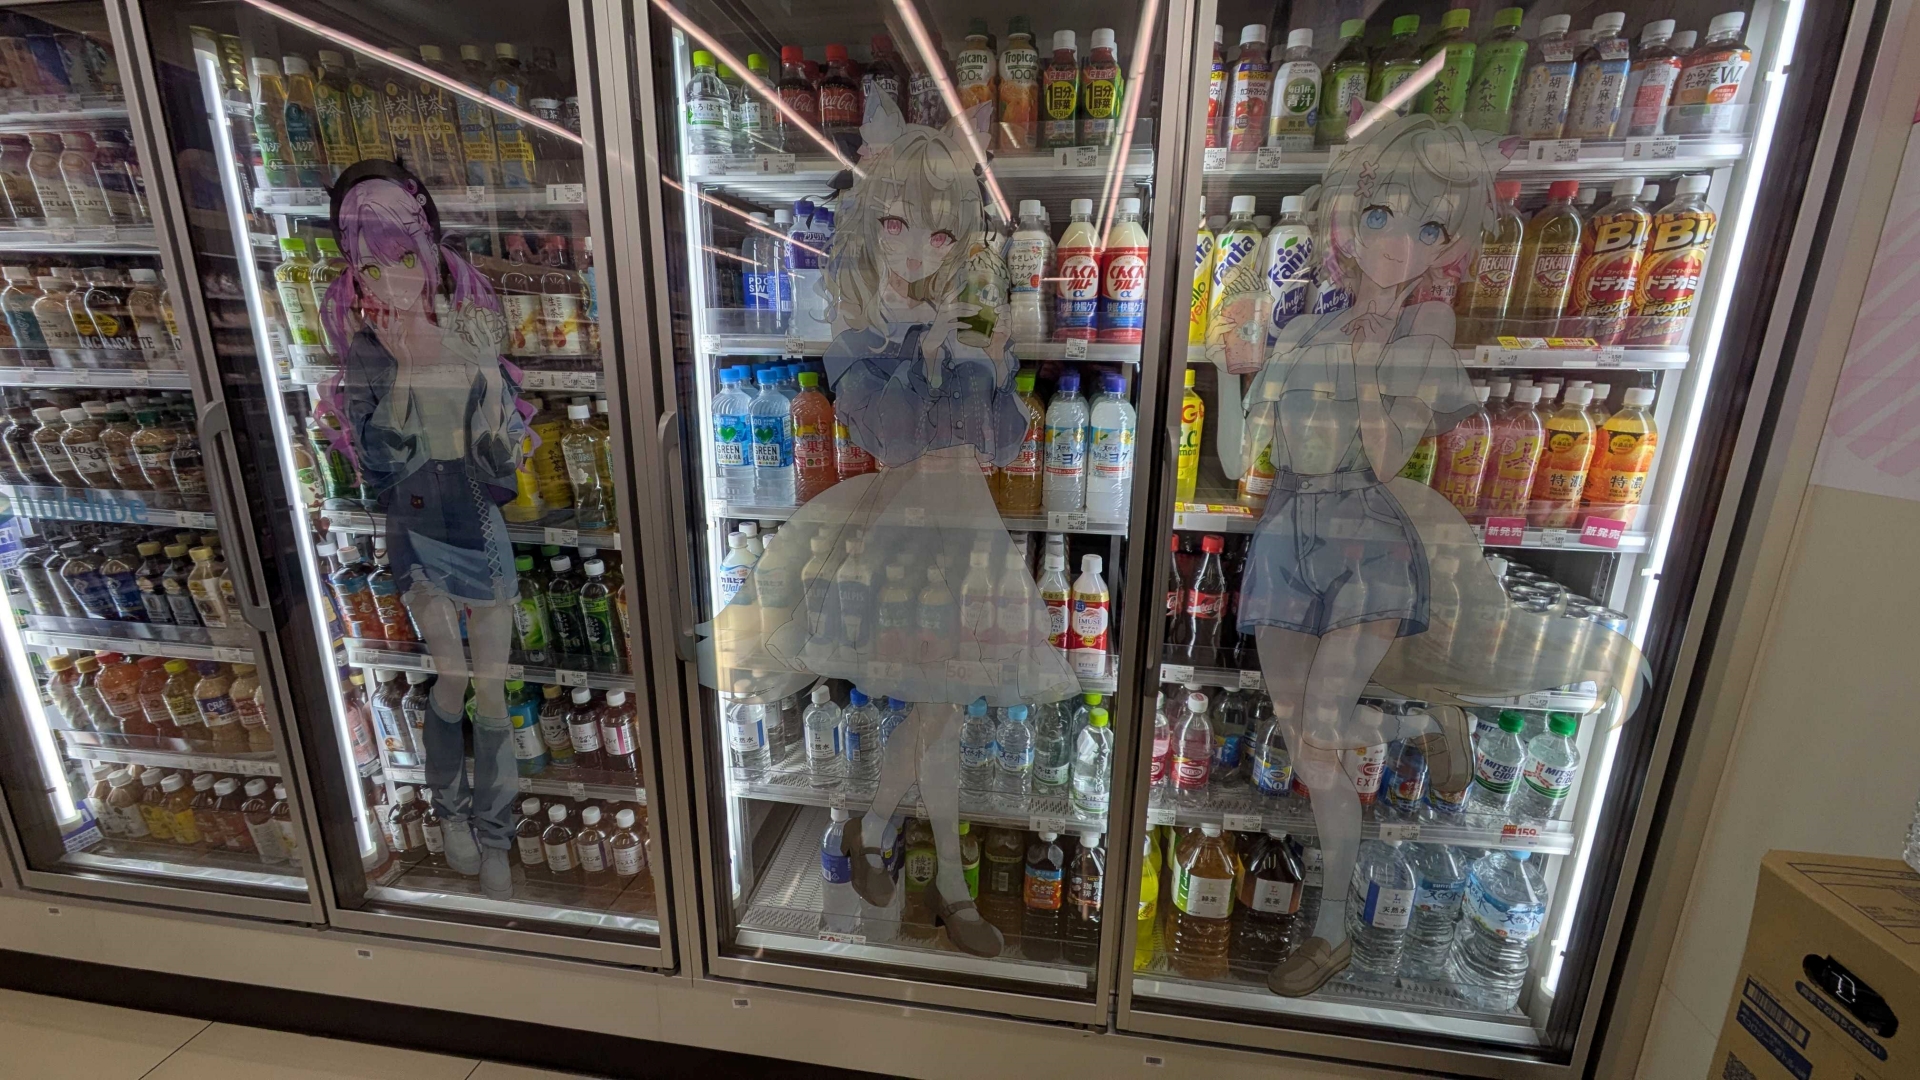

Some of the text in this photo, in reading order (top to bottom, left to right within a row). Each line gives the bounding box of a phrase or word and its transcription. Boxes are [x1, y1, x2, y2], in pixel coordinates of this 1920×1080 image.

[1287, 95, 1314, 107] 青汁
[1541, 76, 1562, 130] 胡麻麦茶
[1594, 74, 1614, 129] 胡麻麦茶
[1212, 235, 1256, 288] Fanta
[1267, 236, 1313, 288] Fanta
[70, 445, 106, 460] BOSS
[716, 444, 741, 454] GREEN
[1610, 475, 1644, 489] 特濃
[13, 487, 149, 524] hololive
[1487, 526, 1523, 537] 新発売
[1584, 525, 1621, 540] 新発売
[1517, 827, 1538, 836] 159
[1382, 906, 1407, 914] 天然水
